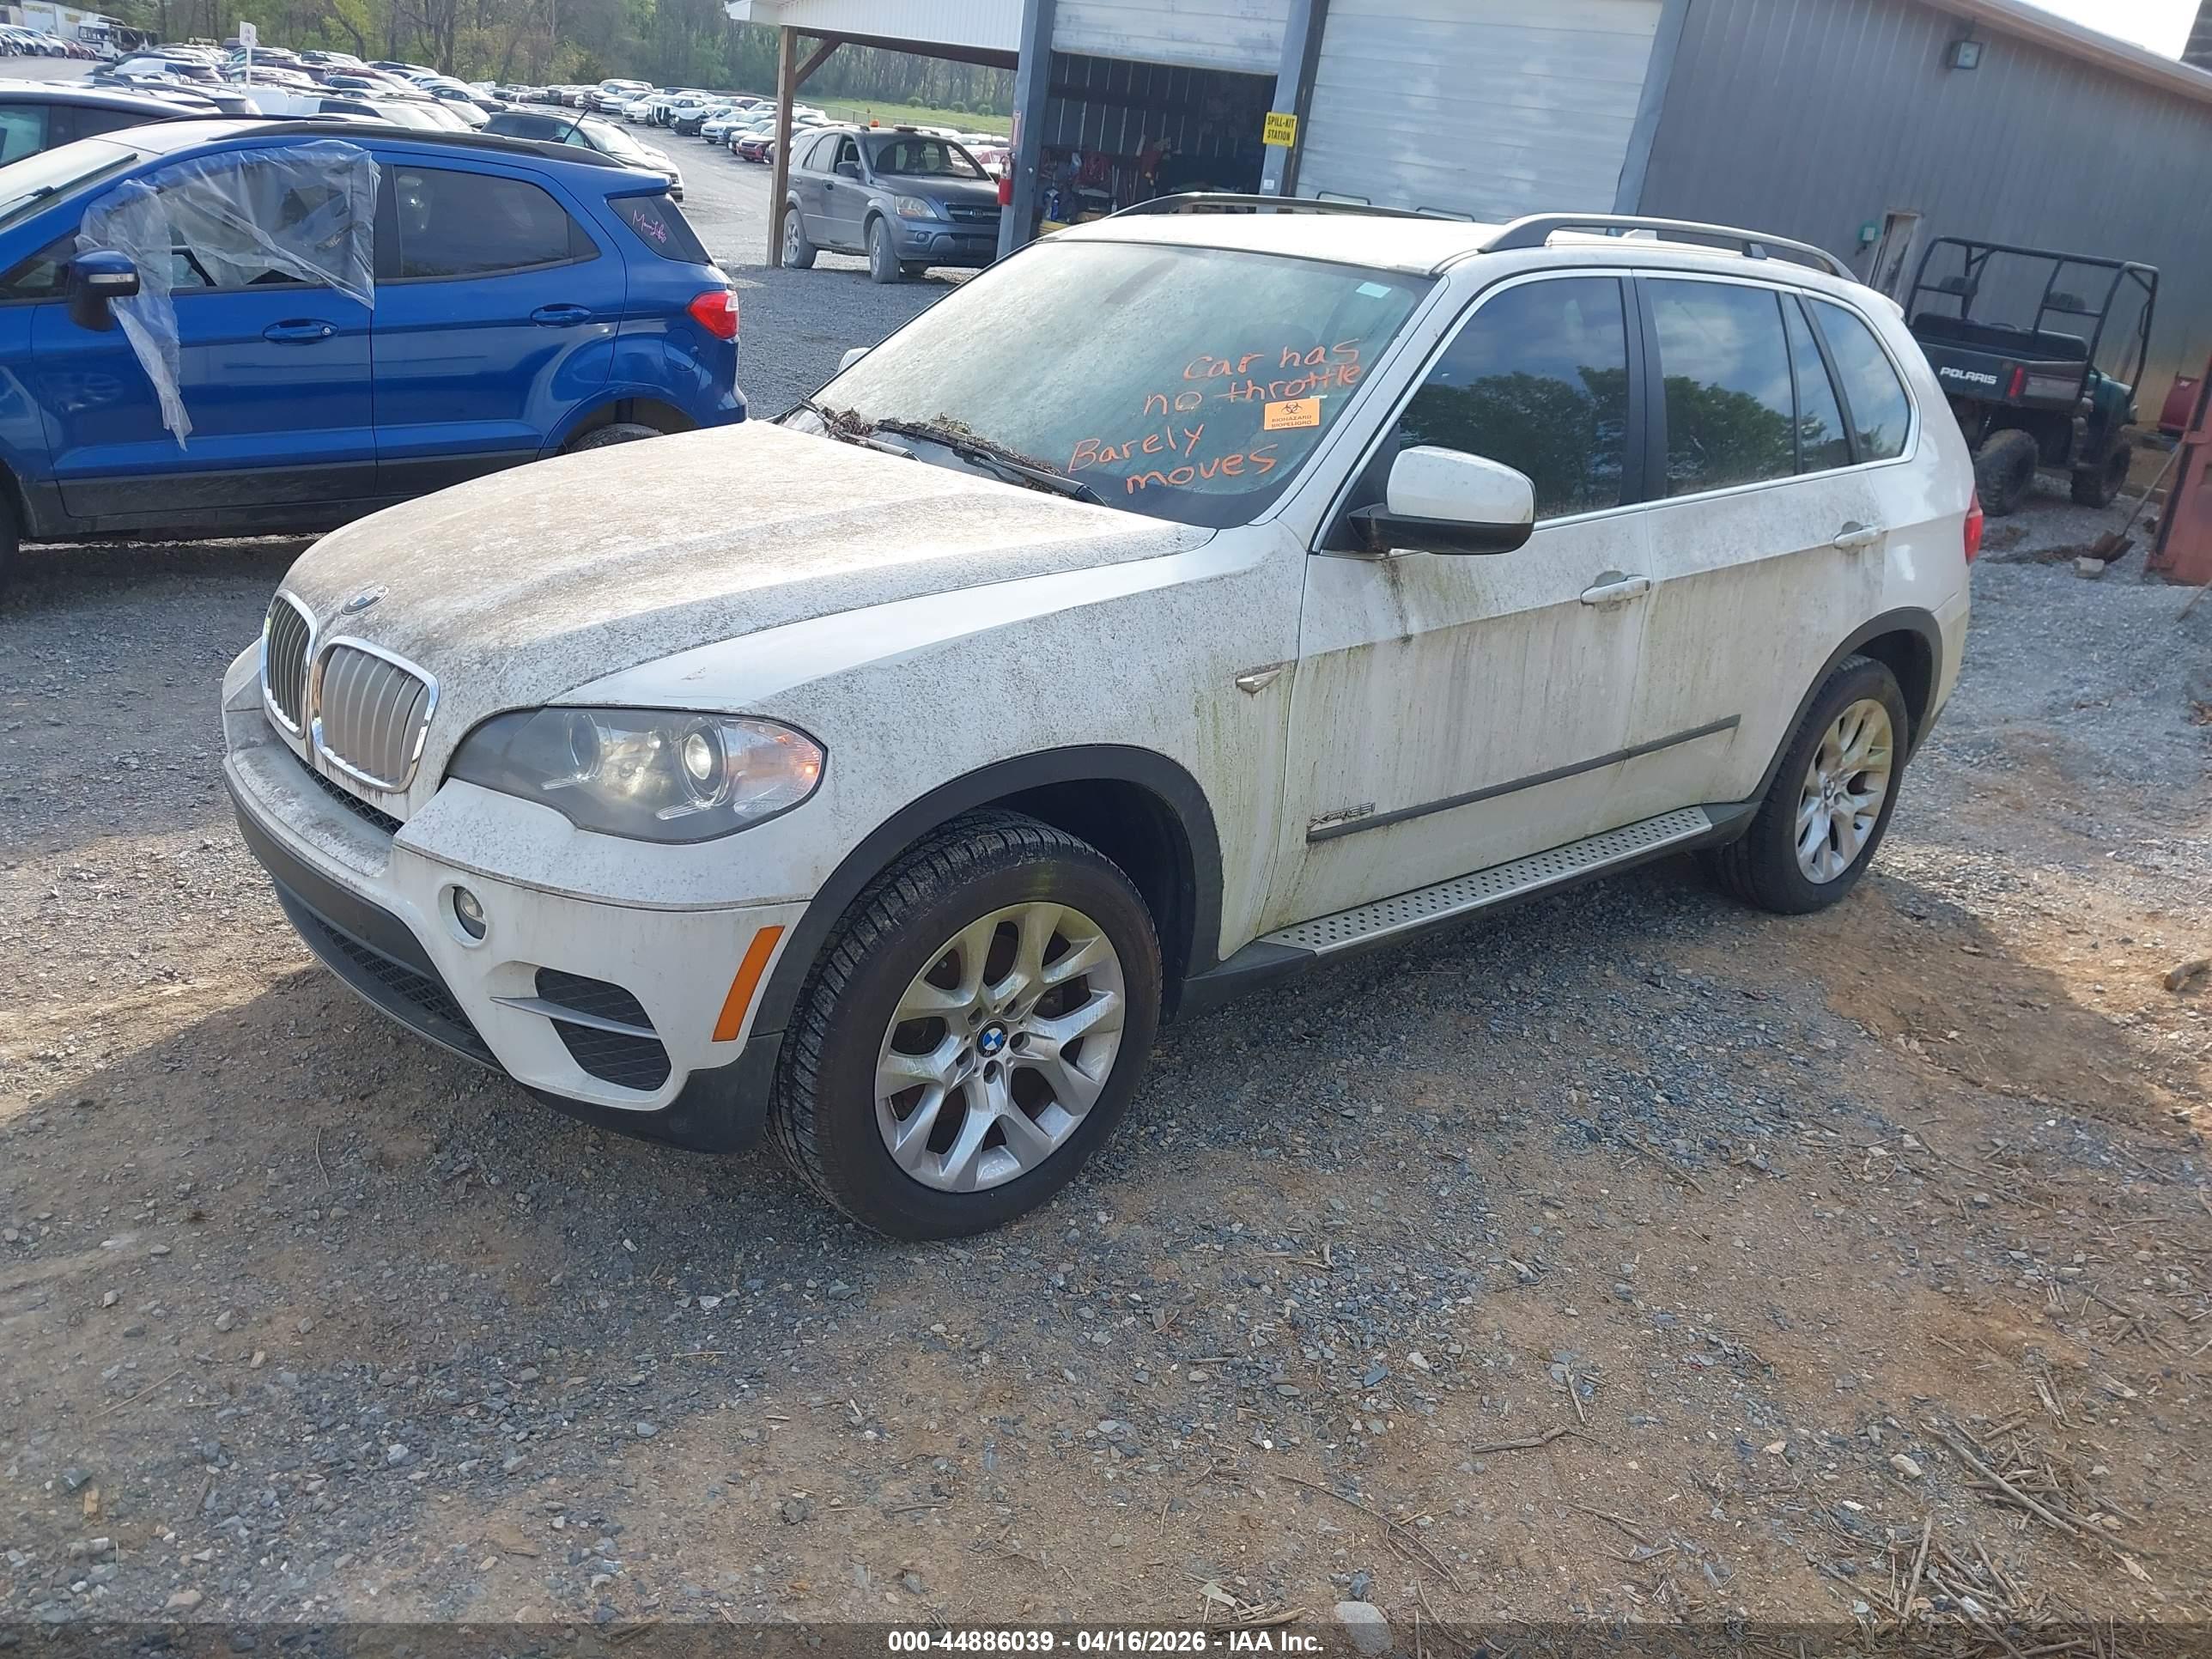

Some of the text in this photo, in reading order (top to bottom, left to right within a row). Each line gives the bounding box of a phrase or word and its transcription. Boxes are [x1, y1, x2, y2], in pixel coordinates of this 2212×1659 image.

[1267, 115, 1296, 129] SPILL-KIT
[1267, 129, 1291, 141] STATION
[1183, 338, 1360, 380] Car has
[1143, 364, 1361, 416] no throttle
[1940, 367, 1998, 386] POLARIS
[1272, 415, 1312, 423] BIOHAZARD
[1068, 423, 1205, 474] Barely
[1126, 443, 1279, 495] moves
